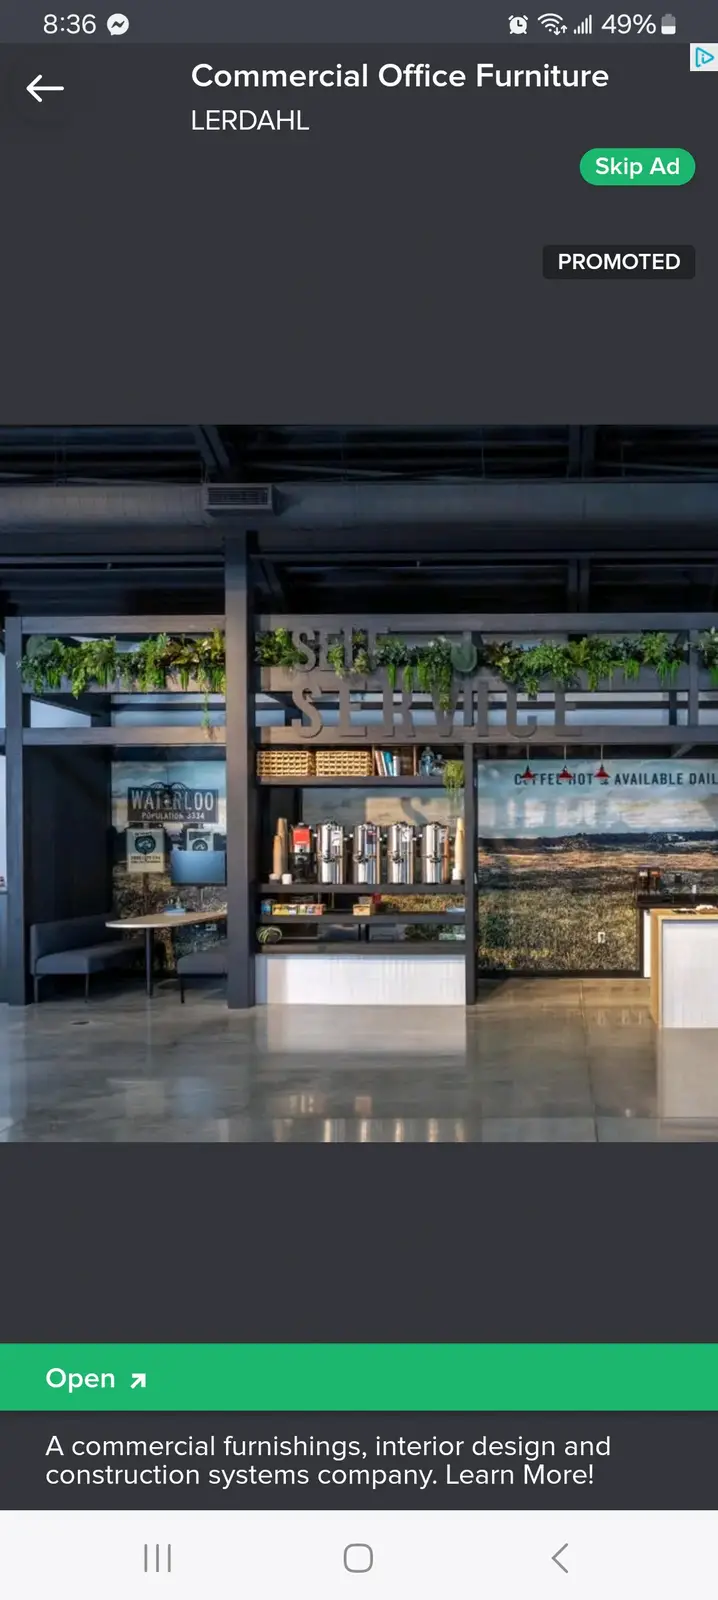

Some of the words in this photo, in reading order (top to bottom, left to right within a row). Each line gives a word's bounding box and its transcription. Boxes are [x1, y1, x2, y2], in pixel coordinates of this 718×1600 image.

[43, 13, 97, 34] 8:36
[601, 13, 657, 35] 49%
[191, 63, 368, 88] Commercial
[378, 63, 467, 88] Office
[476, 63, 609, 88] Furniture
[191, 109, 310, 131] LERDAHL
[595, 156, 643, 180] Skip
[649, 156, 680, 175] Ad
[558, 253, 681, 270] PROMOTED
[291, 677, 584, 738] SERVICE
[568, 773, 593, 785] HOT
[614, 772, 683, 785] AVAILABLE
[45, 1367, 115, 1394] Open
[45, 1436, 64, 1456] A
[71, 1435, 215, 1456] commercial
[223, 1435, 367, 1462] furnishings,
[376, 1435, 465, 1456] interior
[472, 1435, 555, 1462] design
[564, 1435, 611, 1456] and
[45, 1464, 200, 1485] construction
[208, 1465, 310, 1490] systems
[317, 1469, 437, 1490] company.
[446, 1463, 514, 1485] Learn
[523, 1463, 594, 1485] More!
